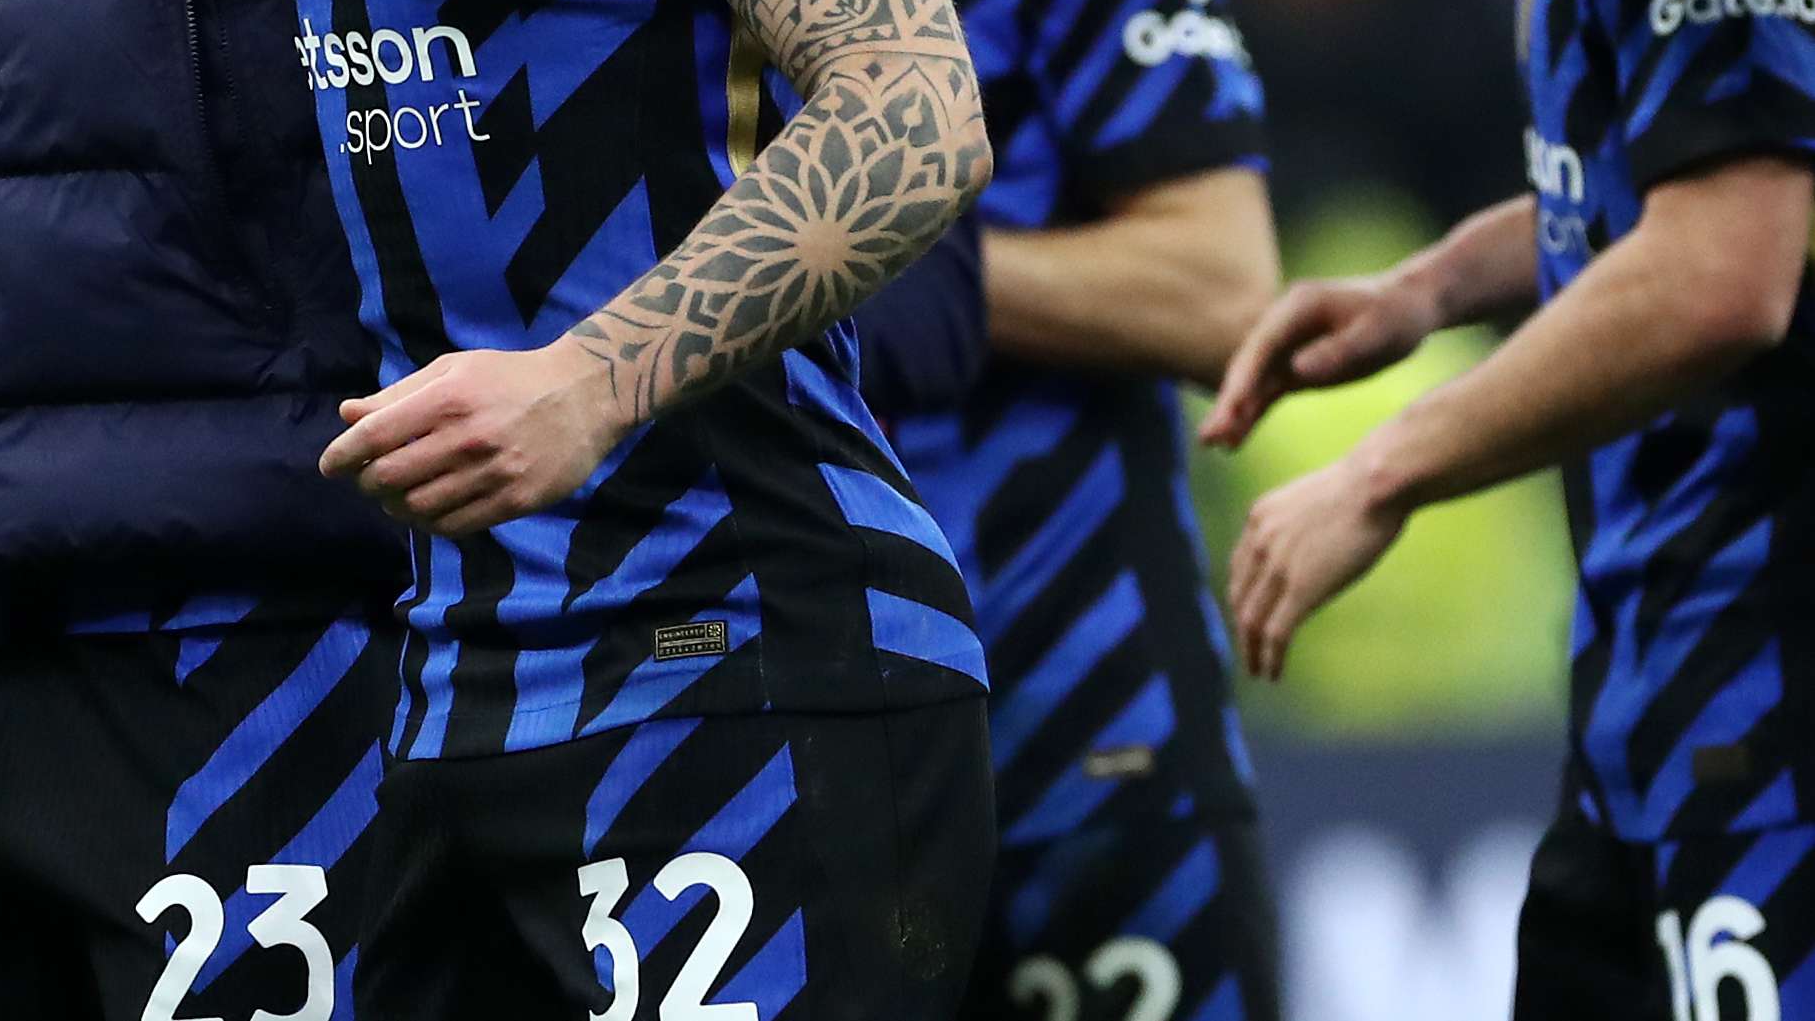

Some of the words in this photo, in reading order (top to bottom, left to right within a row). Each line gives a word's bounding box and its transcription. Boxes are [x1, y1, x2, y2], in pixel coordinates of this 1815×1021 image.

[339, 89, 491, 165] .sport
[135, 864, 335, 1021] 23
[577, 851, 760, 1021] 32
[1656, 895, 1781, 1021] 16
